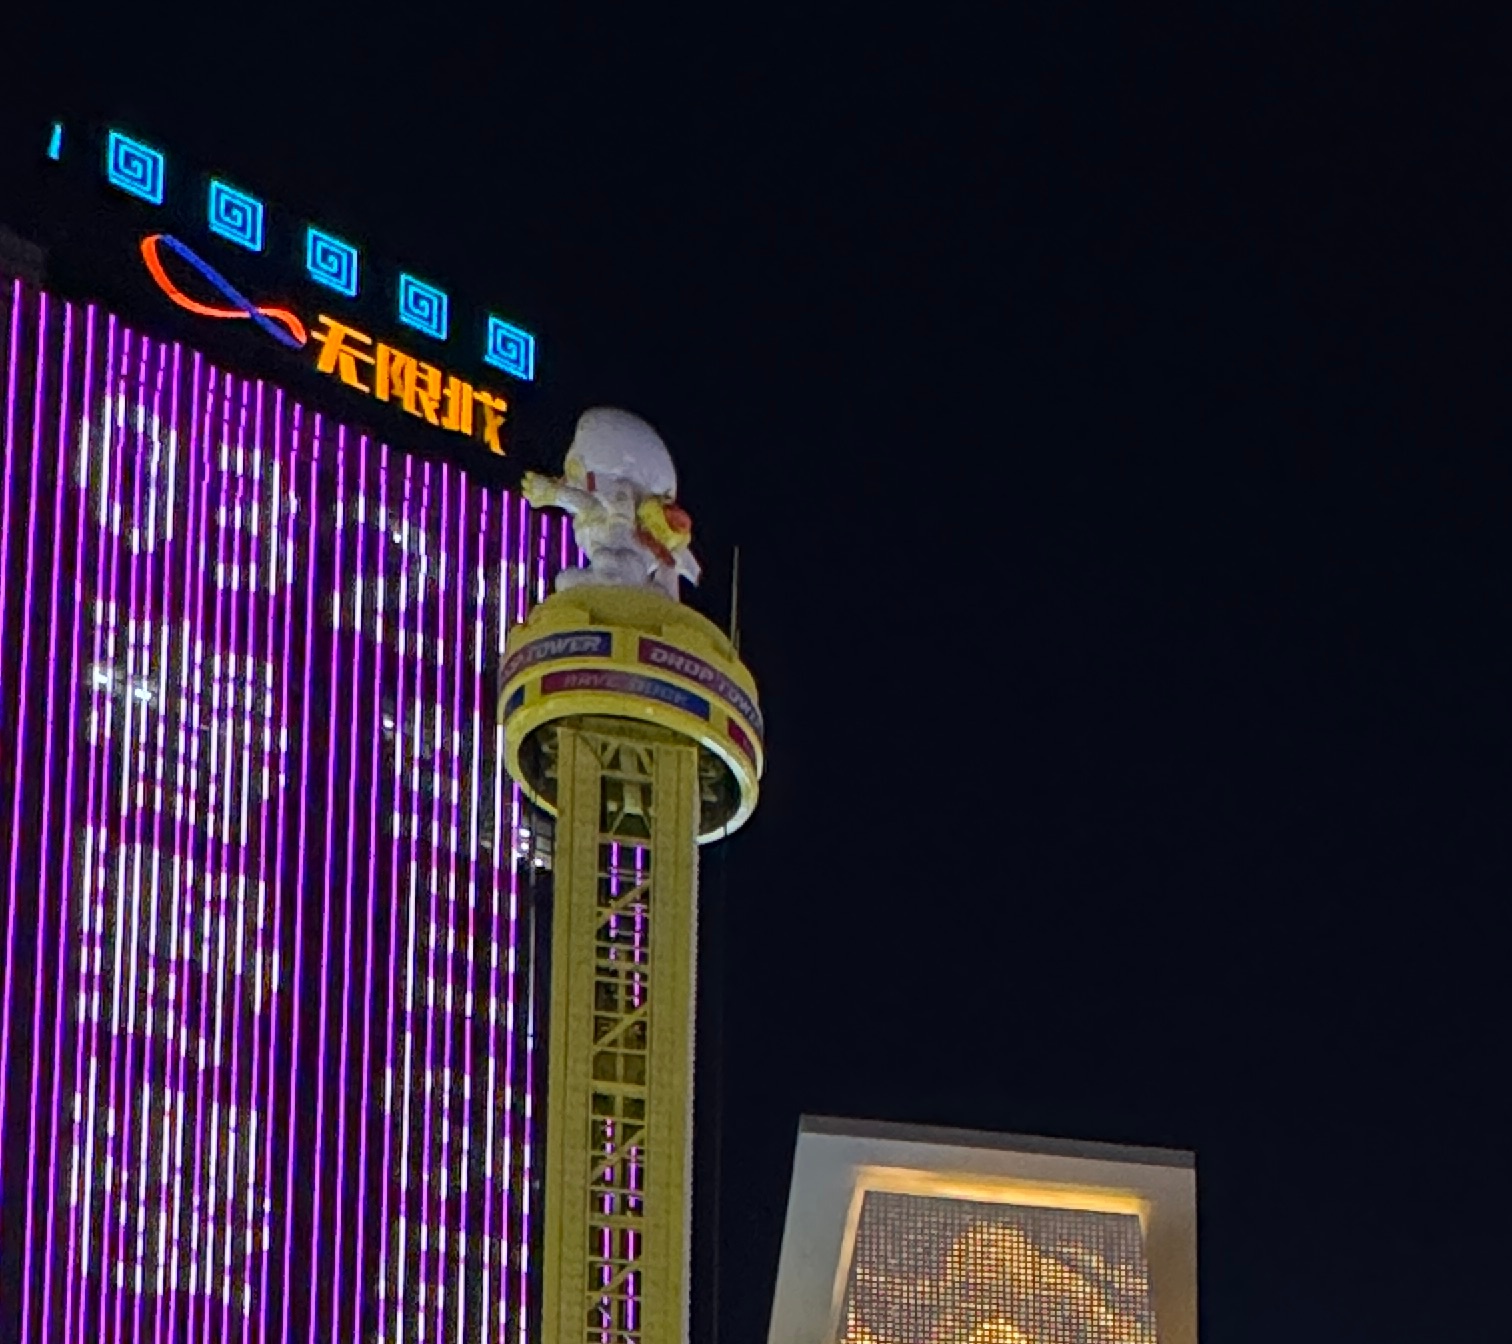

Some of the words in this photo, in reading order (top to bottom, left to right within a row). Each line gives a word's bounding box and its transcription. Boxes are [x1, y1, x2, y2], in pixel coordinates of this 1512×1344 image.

[311, 312, 507, 455] 无限城
[527, 635, 601, 662] TOWER
[650, 648, 714, 681] DROP
